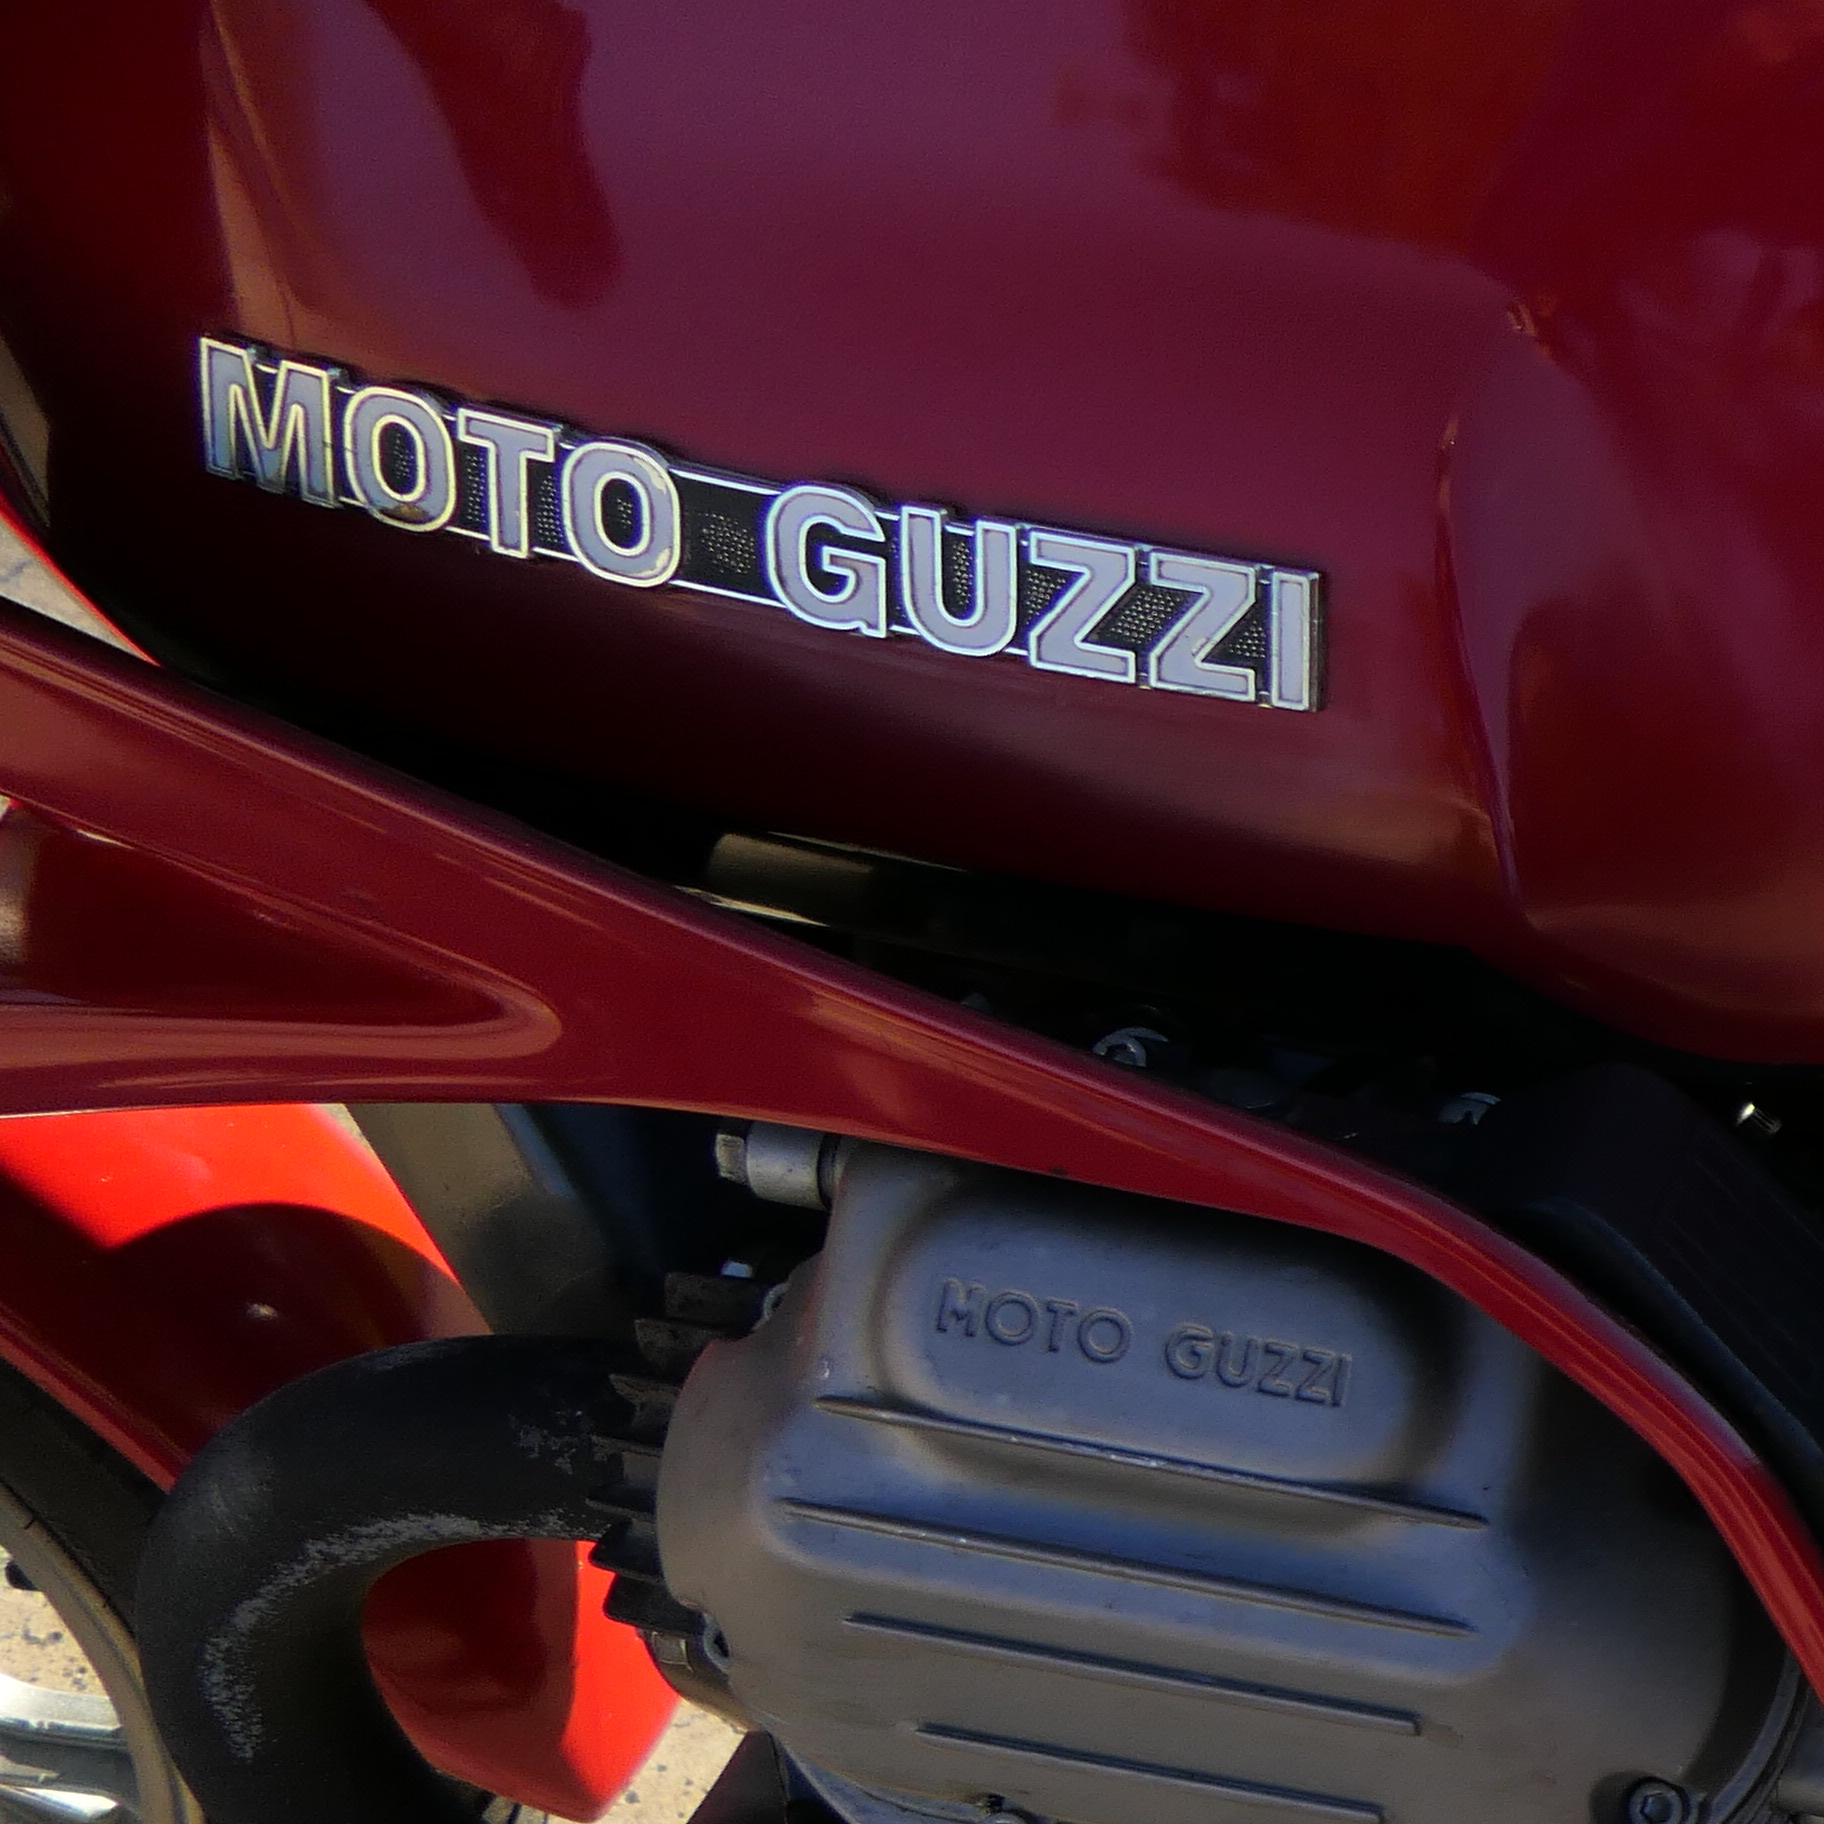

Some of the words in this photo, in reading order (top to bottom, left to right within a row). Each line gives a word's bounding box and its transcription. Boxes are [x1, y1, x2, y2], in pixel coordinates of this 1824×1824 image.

[199, 336, 682, 588] MOTO
[765, 482, 1322, 711] GUZZI
[936, 1277, 1132, 1364] MOTO
[1163, 1322, 1353, 1408] GUZZI
